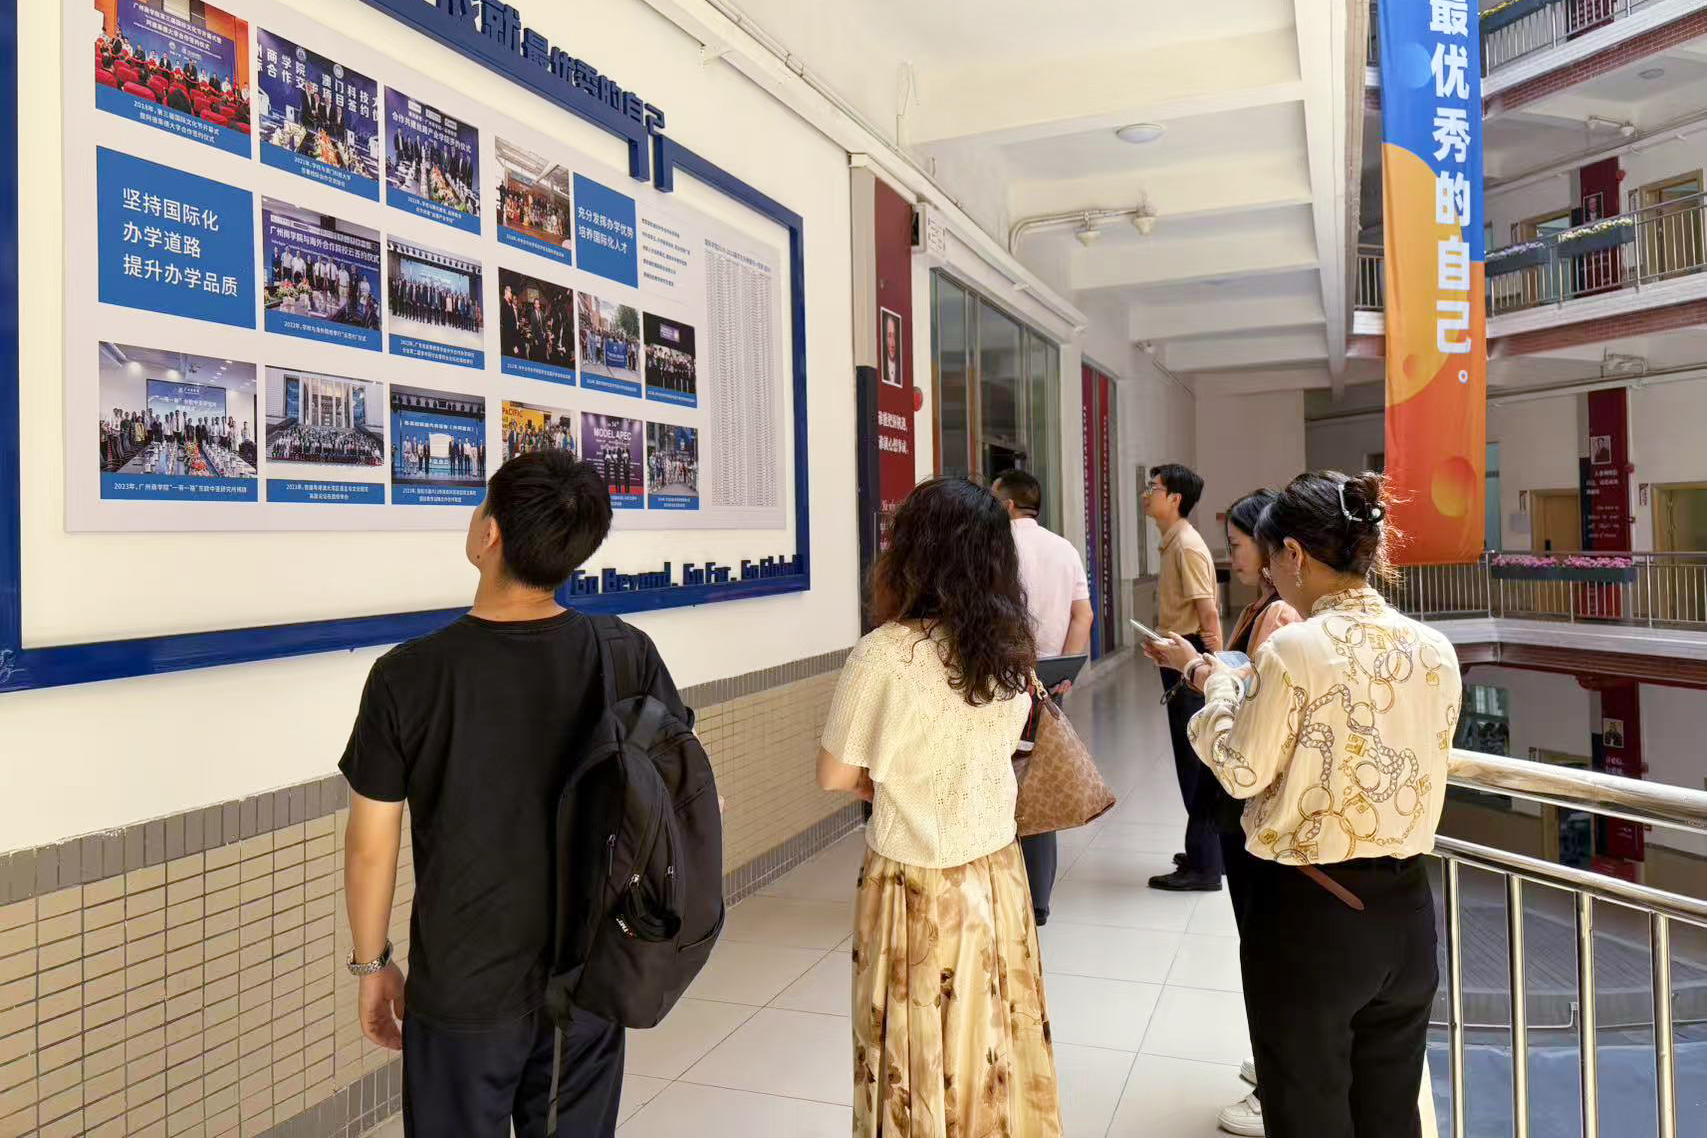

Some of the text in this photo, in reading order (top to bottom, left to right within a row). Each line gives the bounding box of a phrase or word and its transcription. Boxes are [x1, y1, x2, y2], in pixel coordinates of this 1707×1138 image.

[122, 187, 220, 233] 坚持国际化
[577, 206, 634, 240] 充分发挥办学优势
[122, 221, 202, 260] 办学道路
[578, 225, 628, 254] 培养国际化人才
[122, 253, 239, 297] 提升办学品质
[593, 427, 632, 441] MODEL APEC
